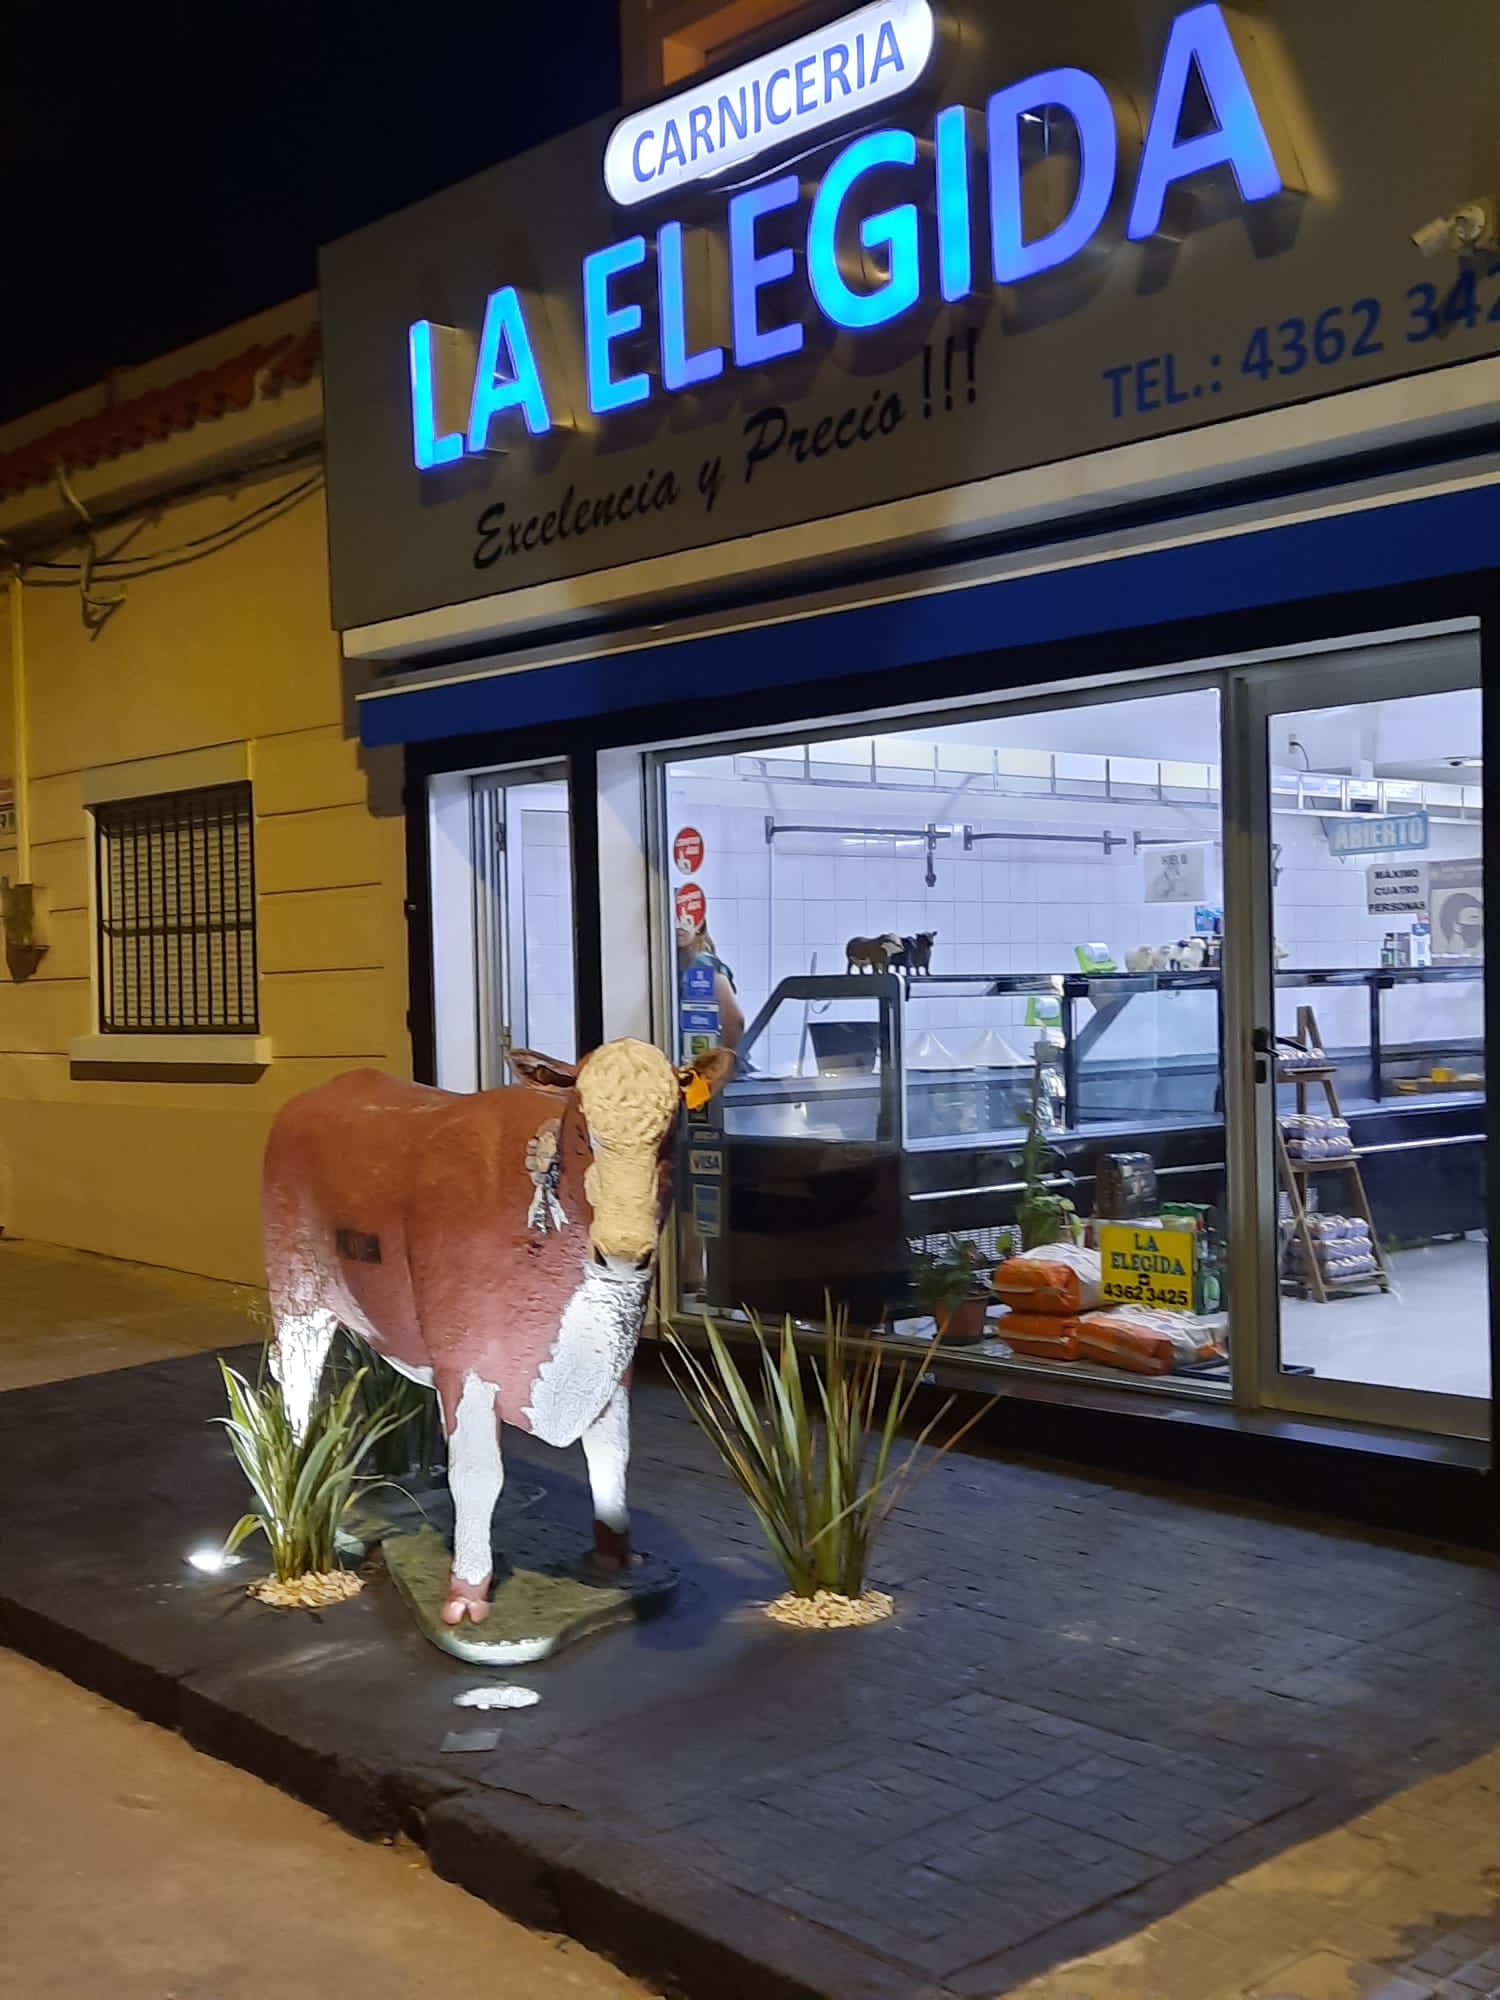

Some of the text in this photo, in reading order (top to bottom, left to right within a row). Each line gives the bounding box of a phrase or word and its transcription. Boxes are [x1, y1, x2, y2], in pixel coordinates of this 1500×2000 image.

[632, 20, 906, 184] CARNICERIA
[409, 2, 1283, 470] LA ELEGIDA
[1102, 353, 1224, 418] TEL.:
[1239, 297, 1384, 382] 4362
[472, 469, 680, 570] Excelencia
[698, 455, 724, 512] y
[743, 386, 904, 484] Precio
[1134, 1232, 1158, 1251] LA
